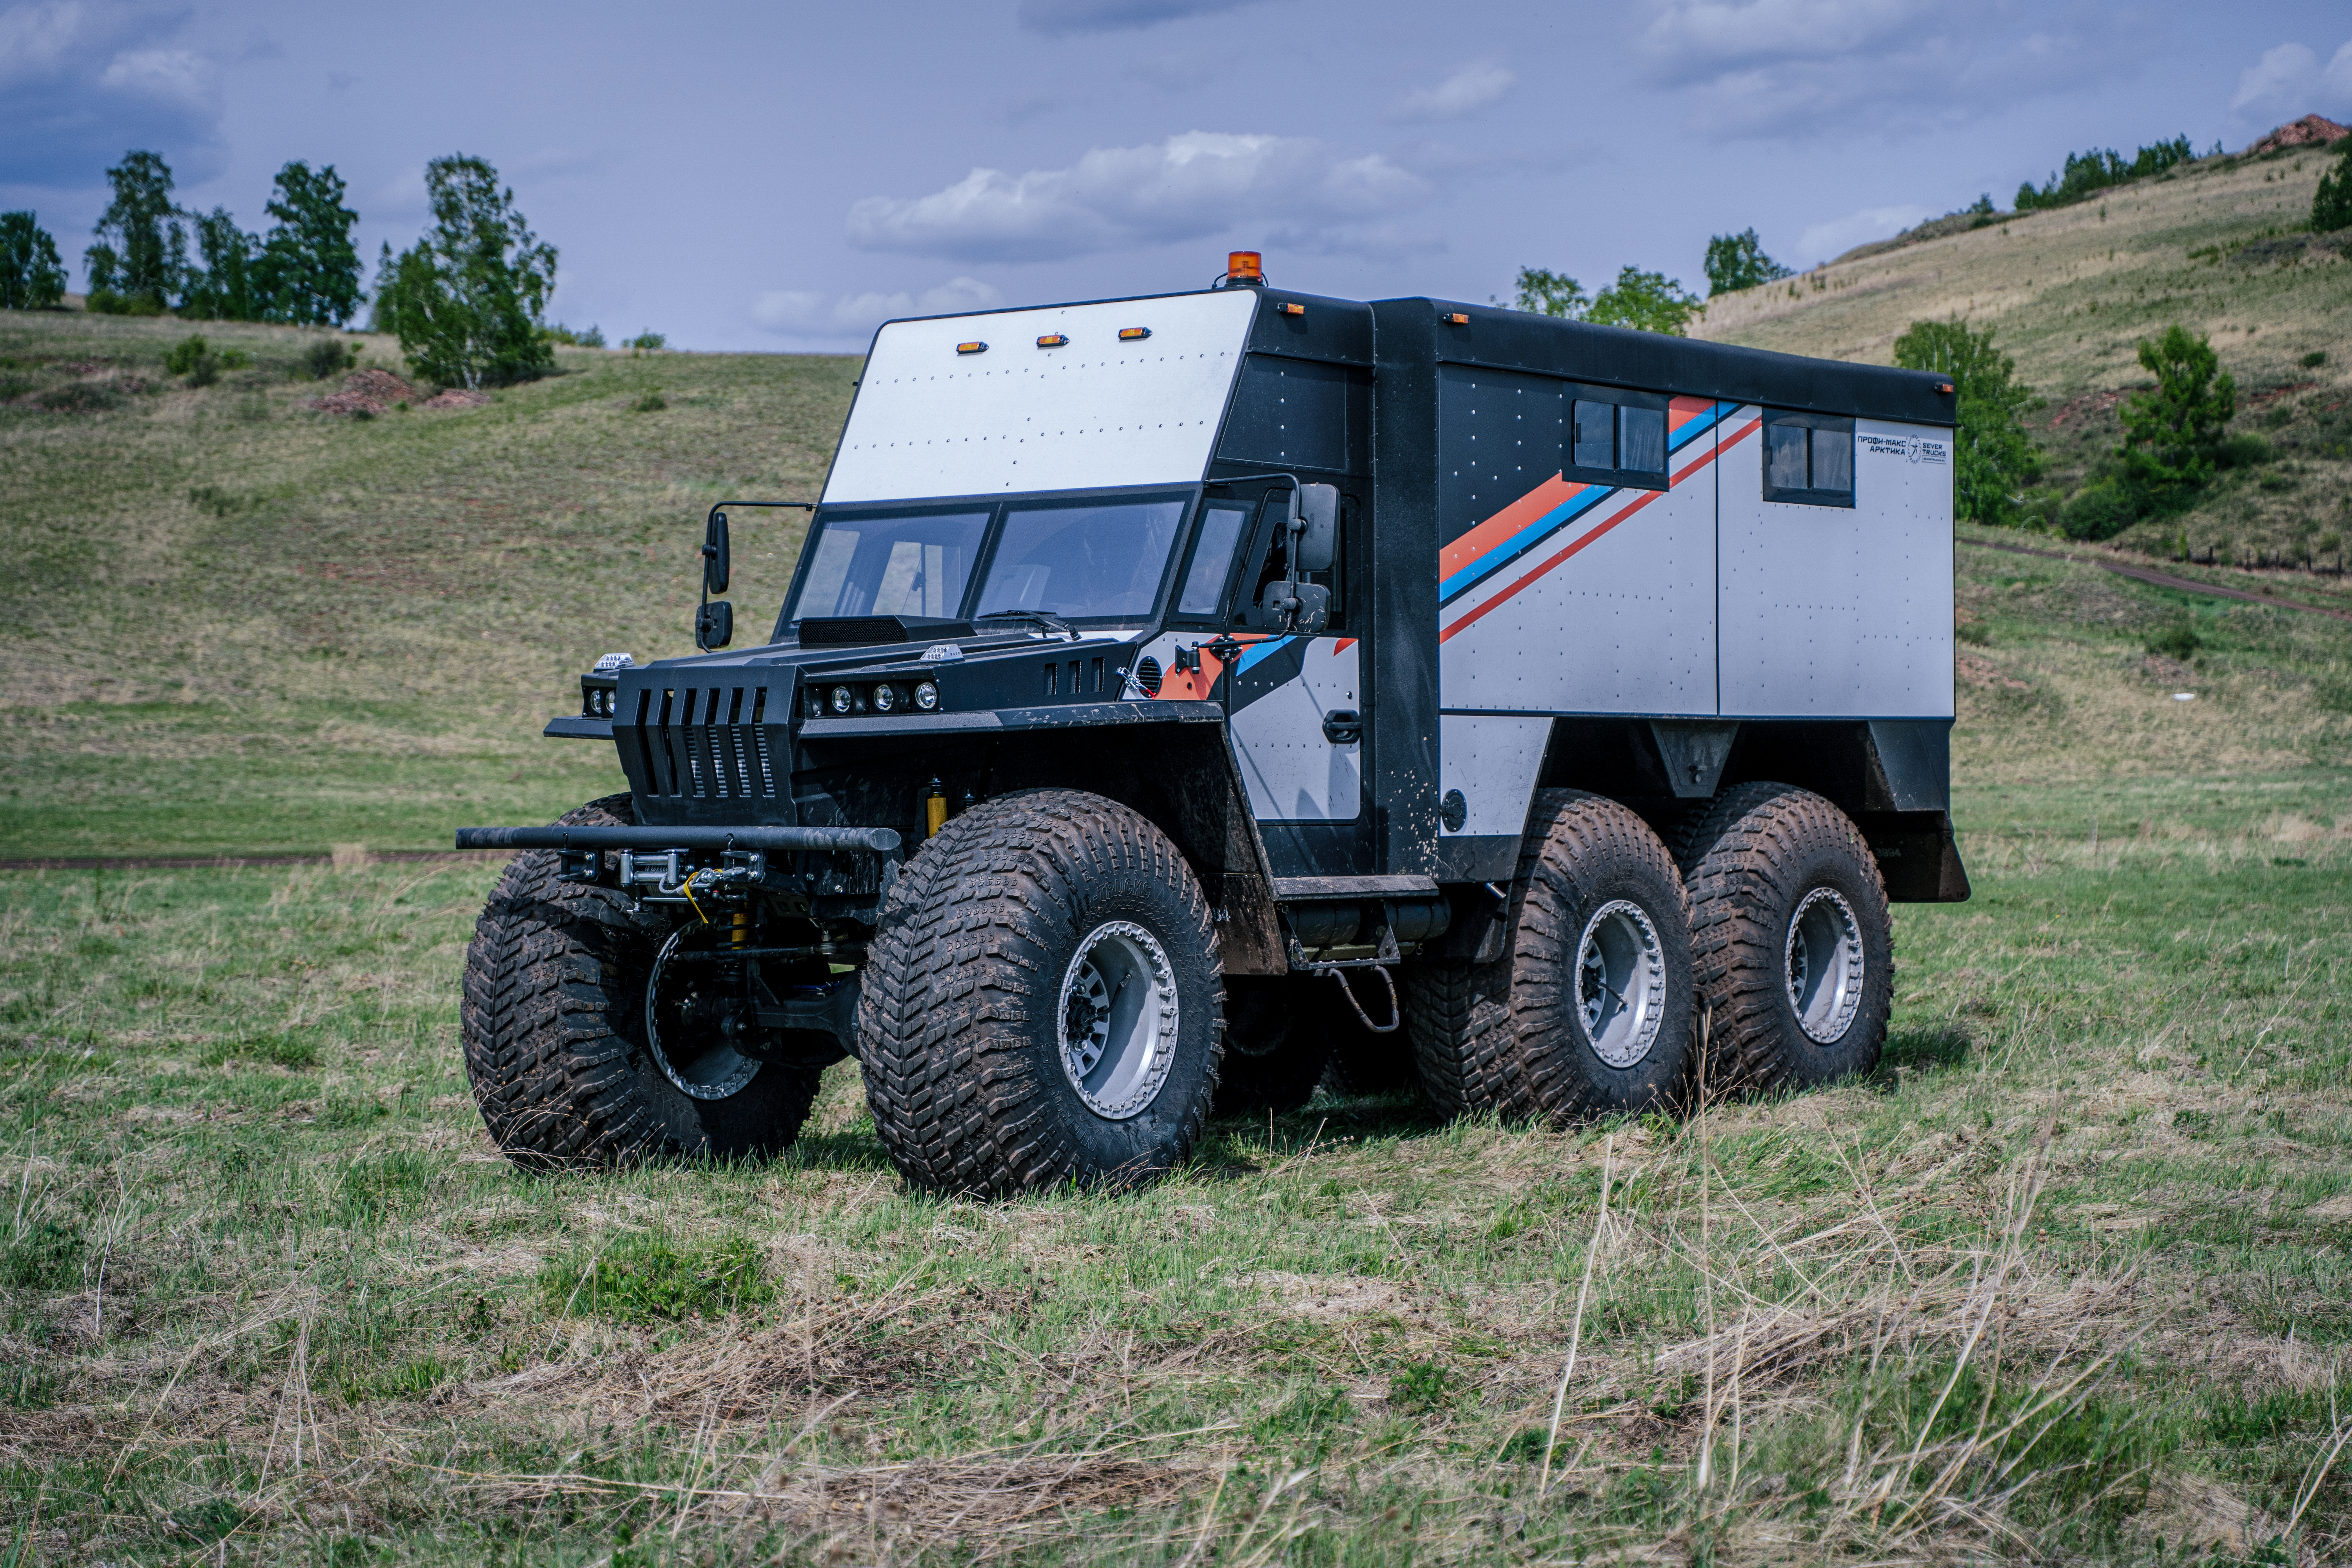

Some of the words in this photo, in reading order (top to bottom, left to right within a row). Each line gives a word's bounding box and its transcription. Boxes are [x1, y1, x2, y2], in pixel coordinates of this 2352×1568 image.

[1857, 436, 1906, 447] ПРОФИ-МАКС
[1869, 446, 1905, 456] АРКТИКА
[1056, 878, 1151, 949] SEVER-TRUCKS
